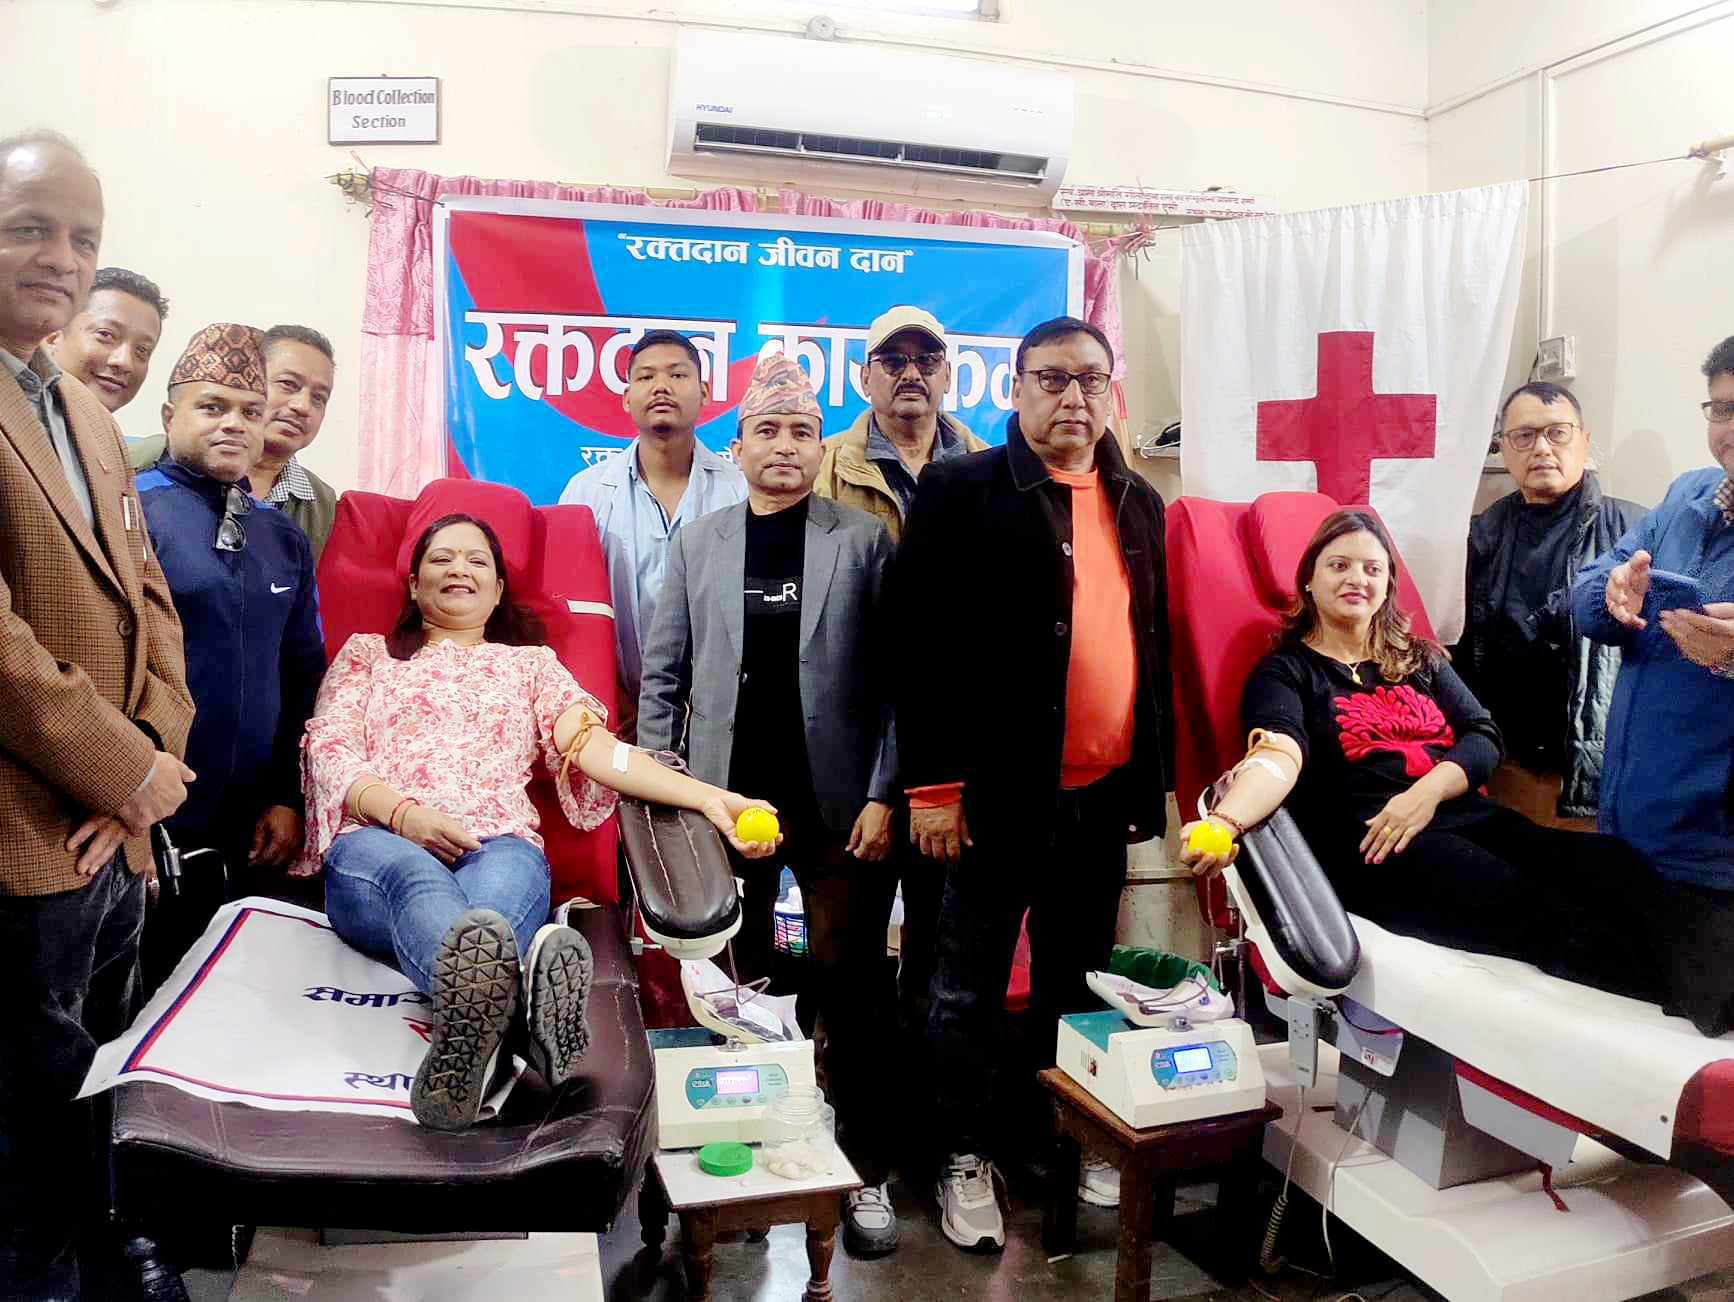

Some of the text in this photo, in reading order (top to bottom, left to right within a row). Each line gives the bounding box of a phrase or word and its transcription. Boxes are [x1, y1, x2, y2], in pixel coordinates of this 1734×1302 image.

[332, 88, 436, 105] Blood Collection
[351, 114, 406, 128] Section
[758, 236, 842, 270] जीवन
